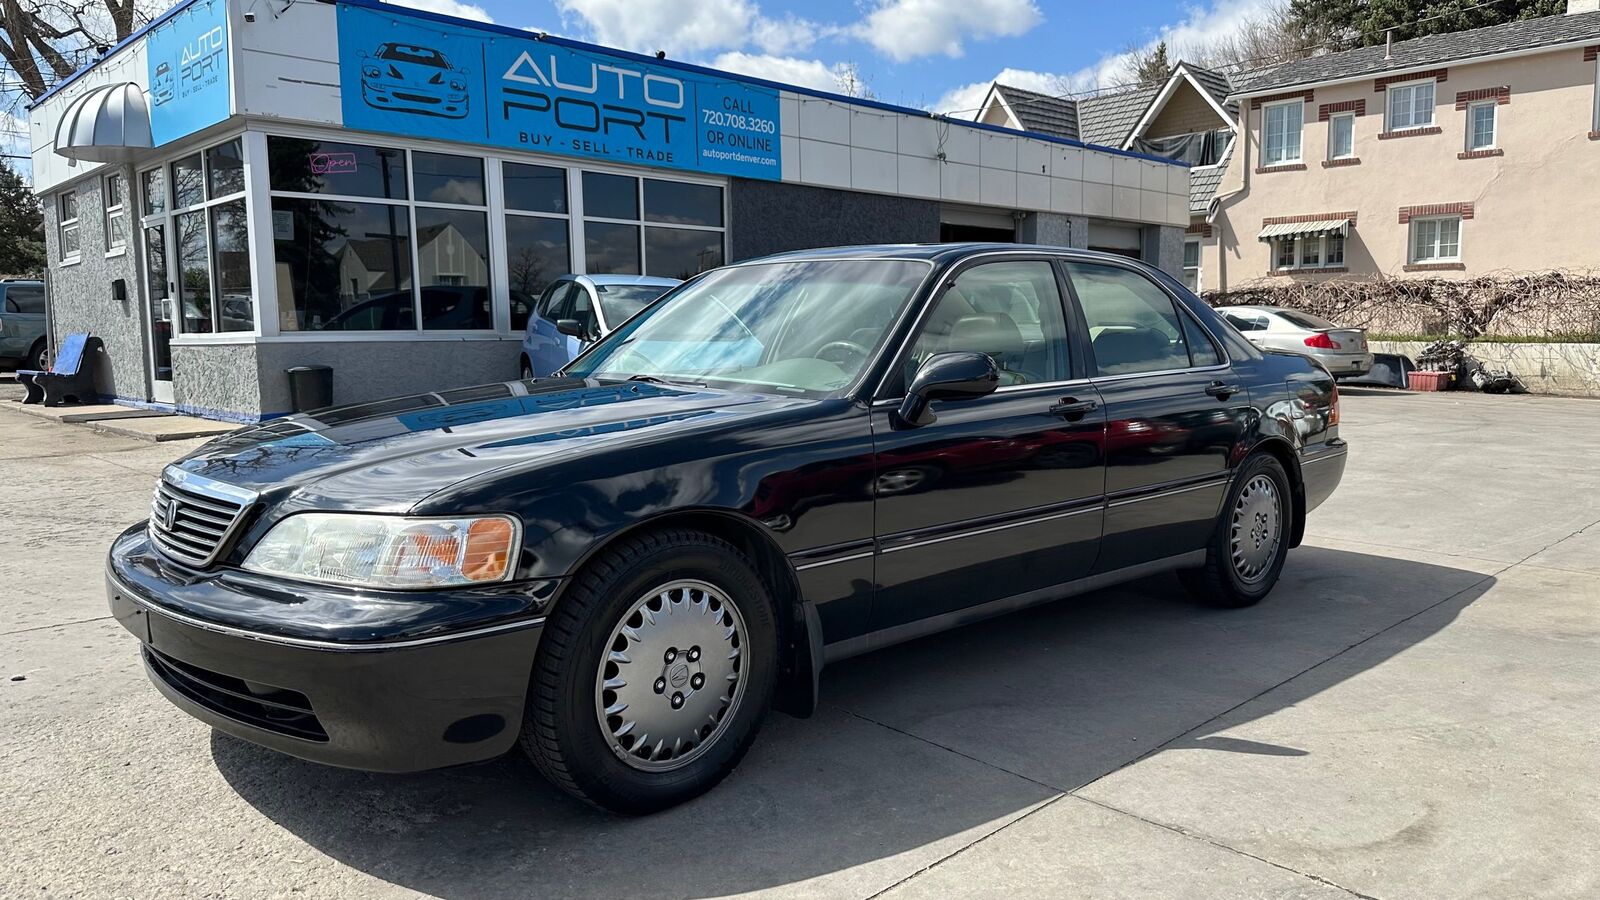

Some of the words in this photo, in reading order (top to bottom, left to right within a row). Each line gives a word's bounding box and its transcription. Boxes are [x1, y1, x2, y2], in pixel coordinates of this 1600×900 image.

[181, 26, 223, 65] AUTO
[181, 48, 223, 87] PORT
[502, 50, 685, 109] AUTO
[193, 85, 202, 94] SELL
[204, 75, 218, 87] TRADE
[502, 87, 686, 143] PORT
[723, 96, 754, 114] CALL
[702, 109, 775, 134] 720.708.3260
[519, 131, 553, 146] BUY
[572, 139, 610, 154] SELL
[626, 146, 674, 162] TRADE
[707, 130, 725, 145] OR
[728, 133, 772, 152] ONLINE
[311, 153, 354, 173] Open
[702, 149, 777, 166] autoportdenver.com
